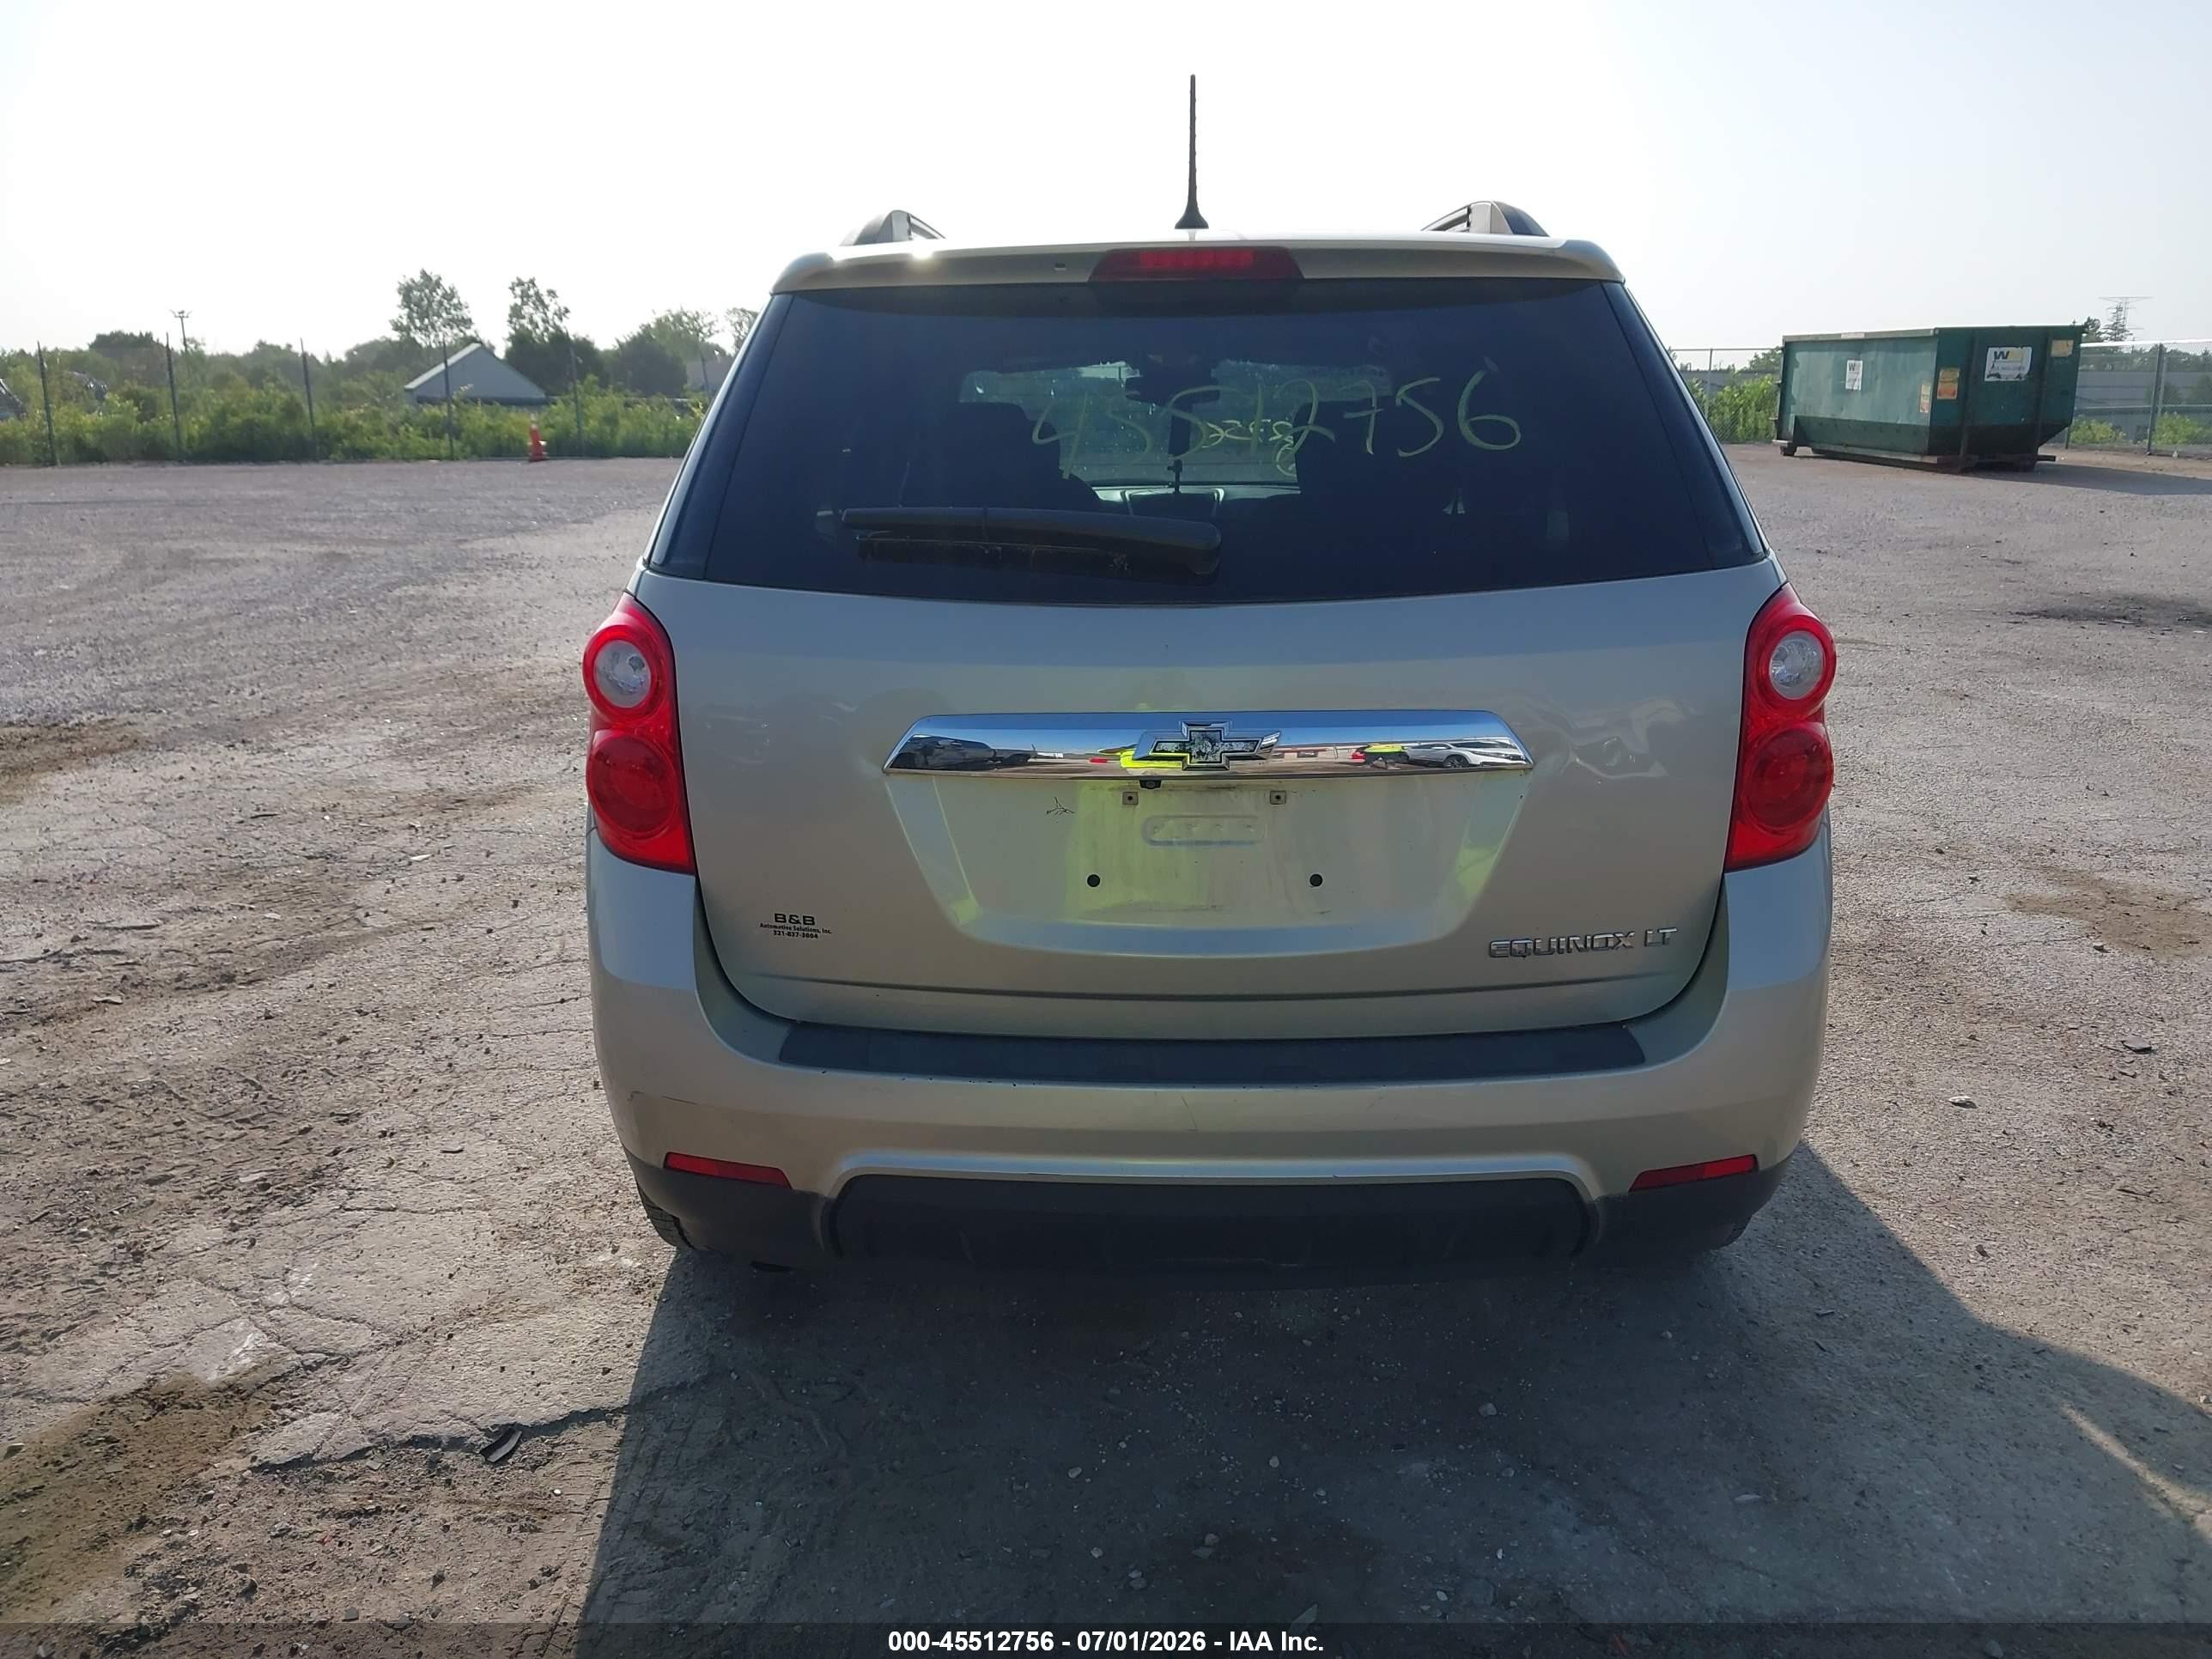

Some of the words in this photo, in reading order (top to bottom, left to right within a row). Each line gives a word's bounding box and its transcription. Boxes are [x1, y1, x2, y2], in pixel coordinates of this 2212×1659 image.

[1030, 369, 1522, 480] 45512756
[774, 913, 816, 926] B&B
[1489, 931, 1636, 960] EQUINOX
[1644, 927, 1678, 947] LT
